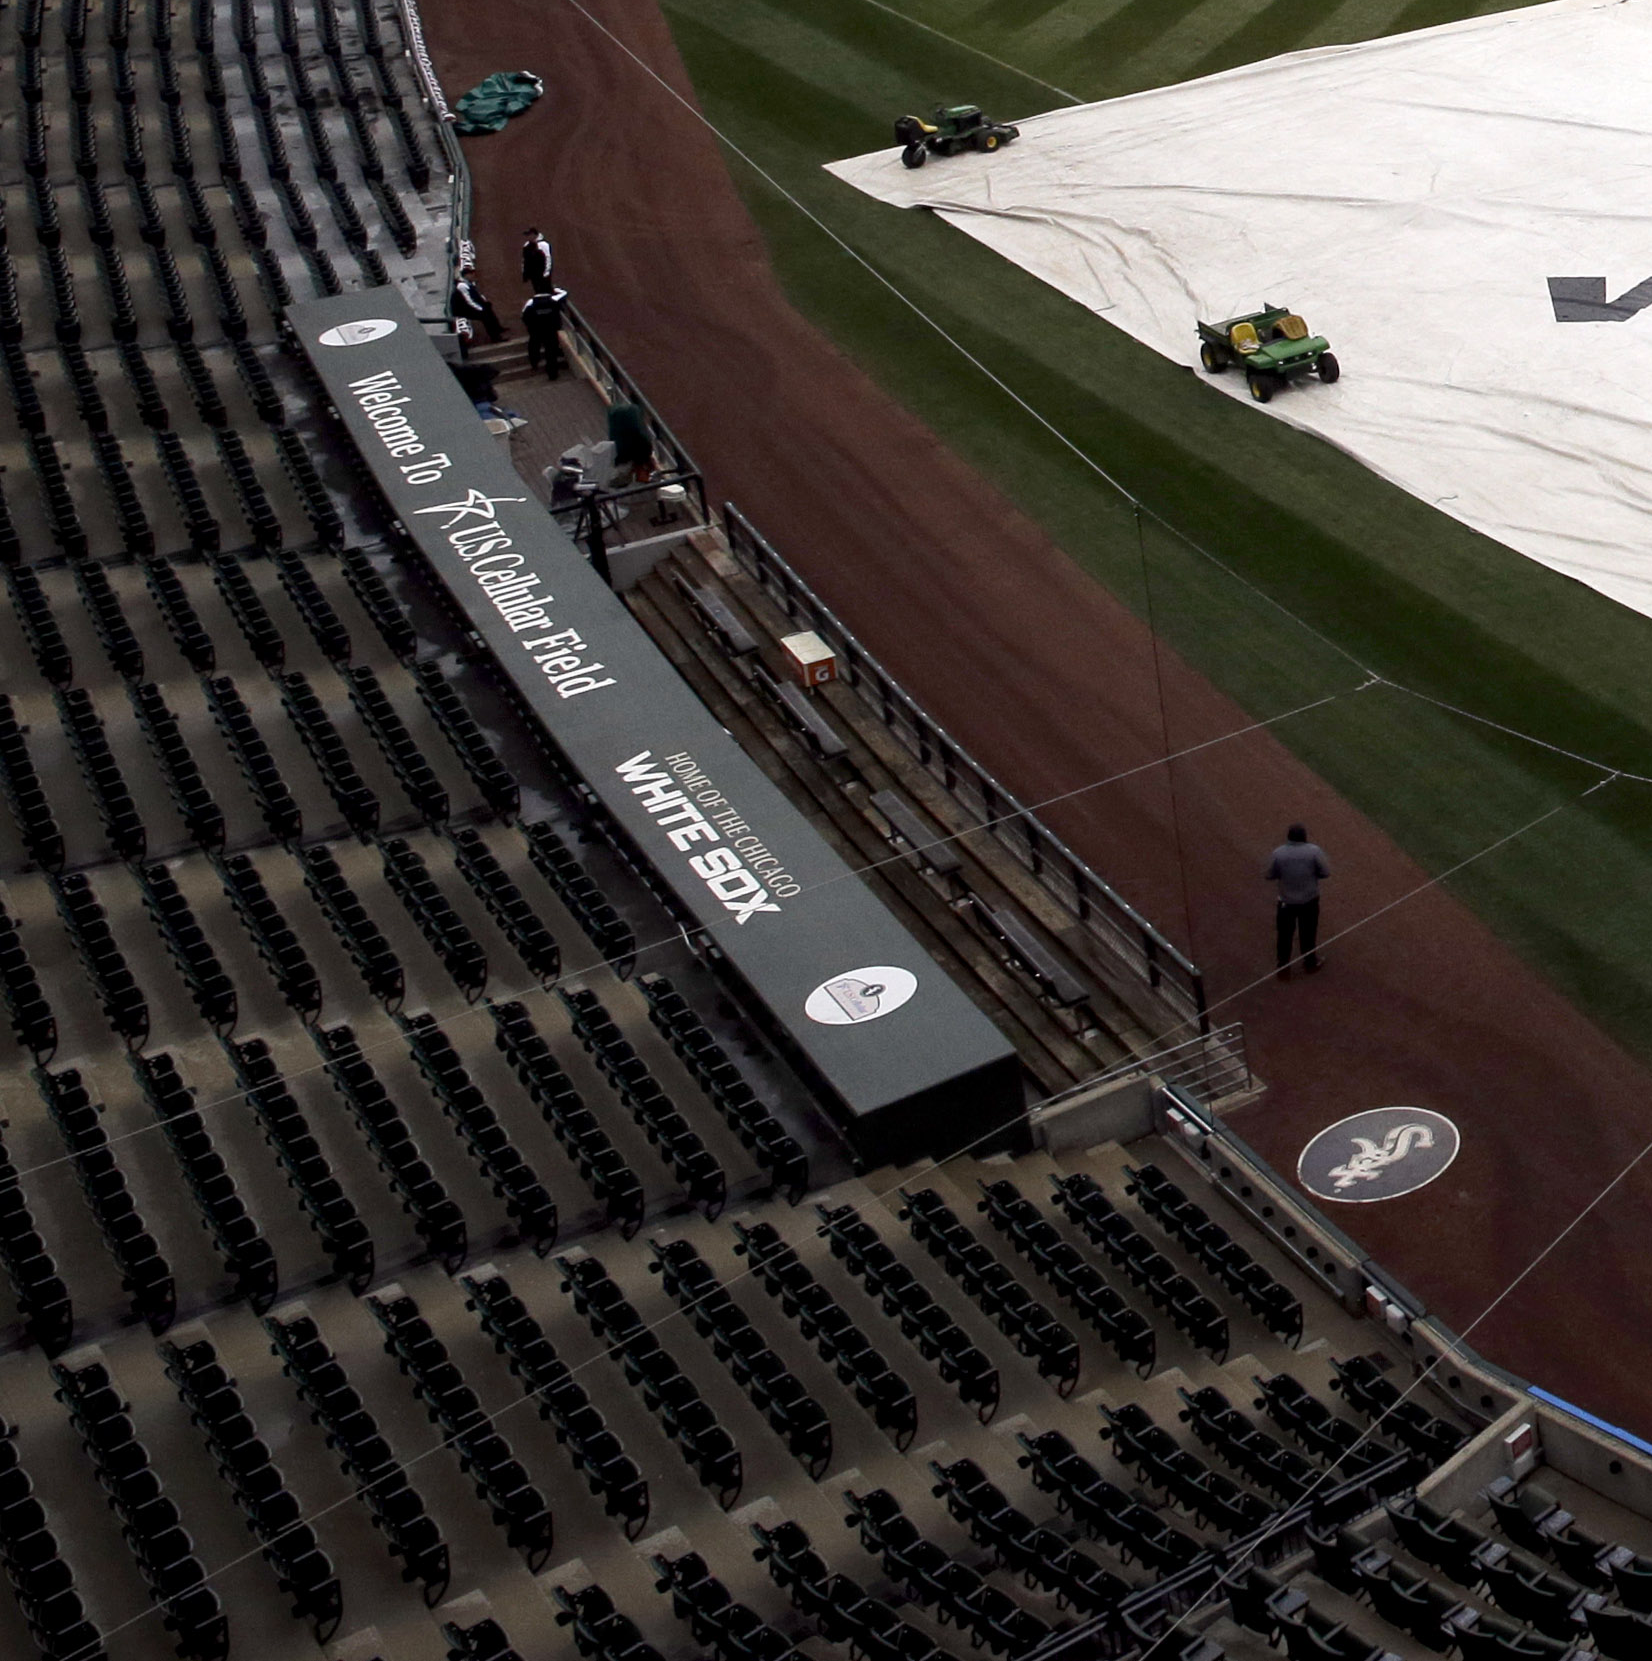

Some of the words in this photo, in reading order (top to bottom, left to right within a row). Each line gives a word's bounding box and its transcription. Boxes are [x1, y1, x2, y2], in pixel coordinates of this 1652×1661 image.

[348, 370, 426, 458] Welcome
[400, 452, 452, 485] To
[522, 628, 618, 699] Field
[815, 665, 831, 683] G
[615, 750, 721, 853] WHITE
[688, 846, 782, 925] SOX
[664, 751, 702, 792] HOME
[695, 781, 727, 809] OF
[711, 806, 752, 839] THE
[734, 829, 801, 899] CHICAGO
